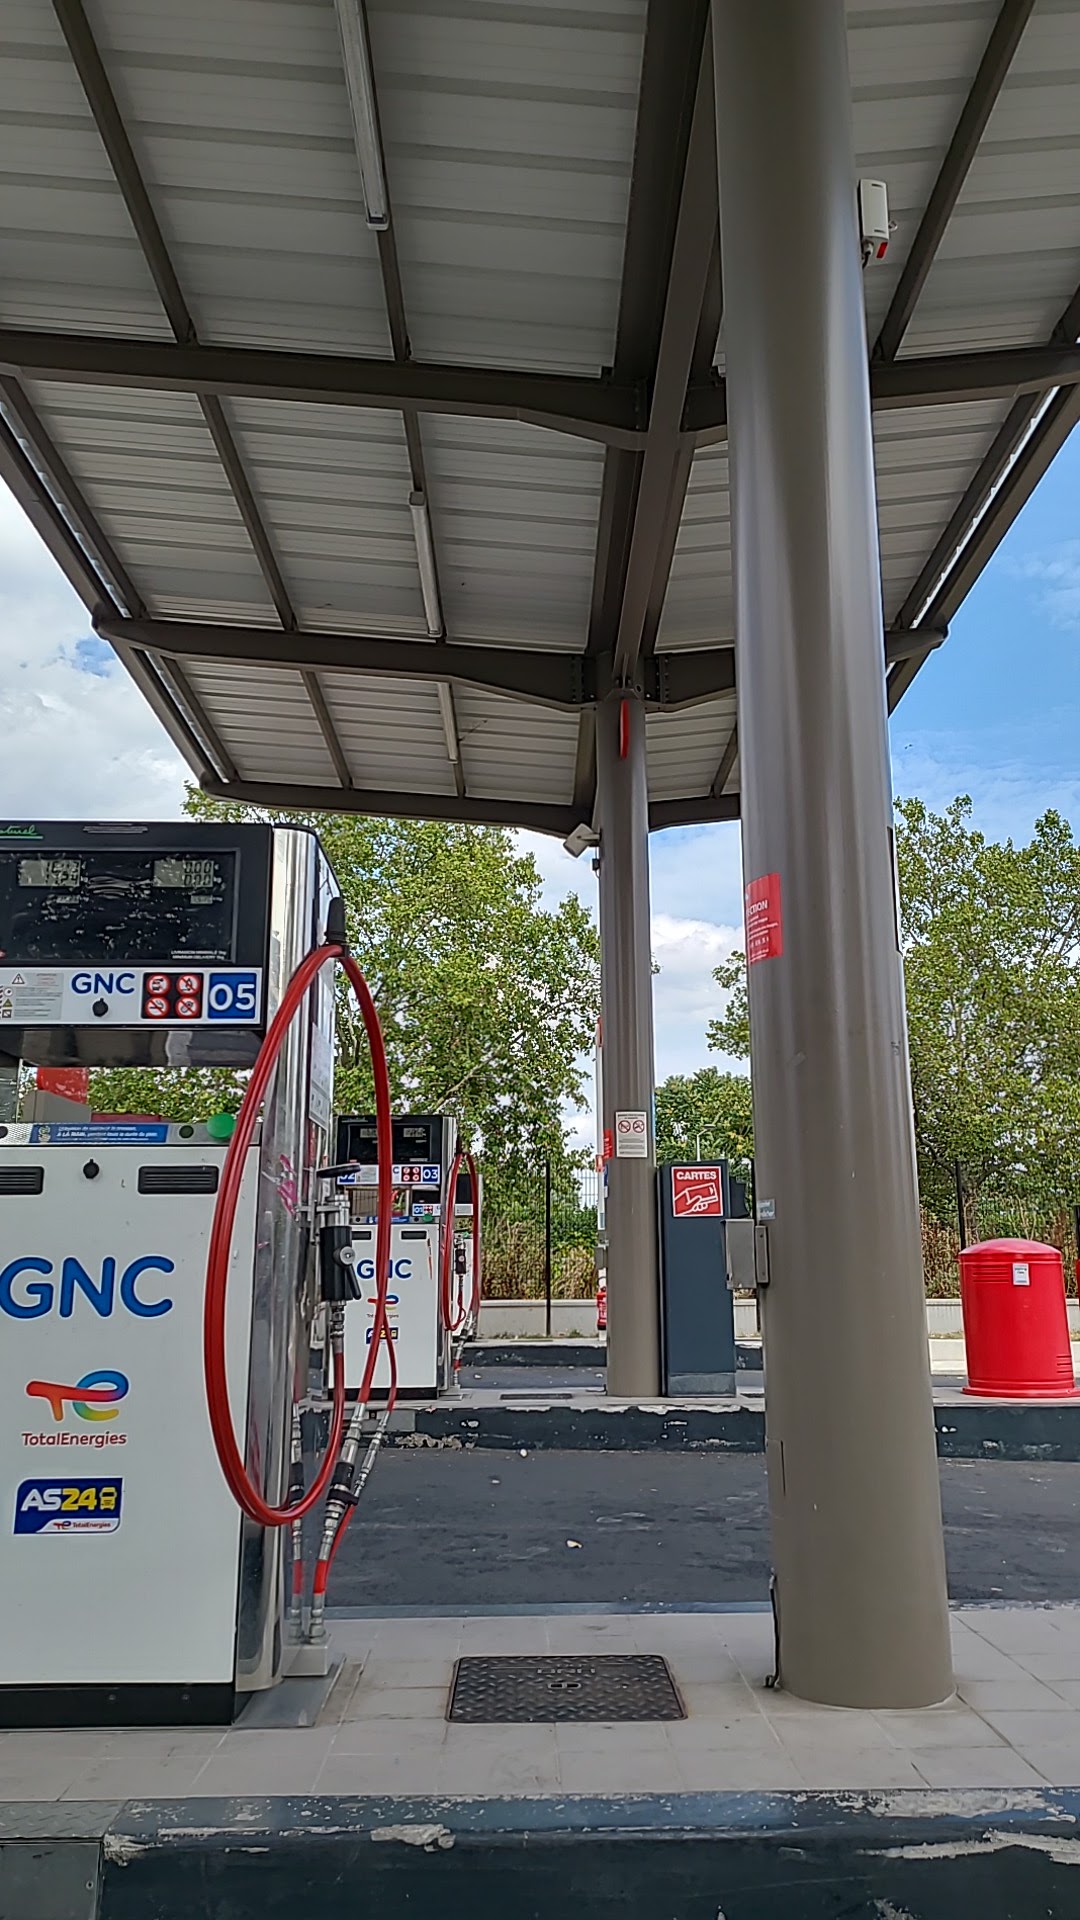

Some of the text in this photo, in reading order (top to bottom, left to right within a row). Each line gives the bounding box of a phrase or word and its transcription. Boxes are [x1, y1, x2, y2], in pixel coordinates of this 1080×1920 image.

[71, 972, 136, 996] GNC
[209, 983, 256, 1011] 05
[423, 1169, 438, 1179] 03
[676, 1171, 717, 1181] CARTES
[0, 1255, 175, 1319] GNC
[22, 1431, 127, 1448] TotalEnergies
[20, 1487, 97, 1511] AS24
[72, 1521, 111, 1529] TotalEnergies
